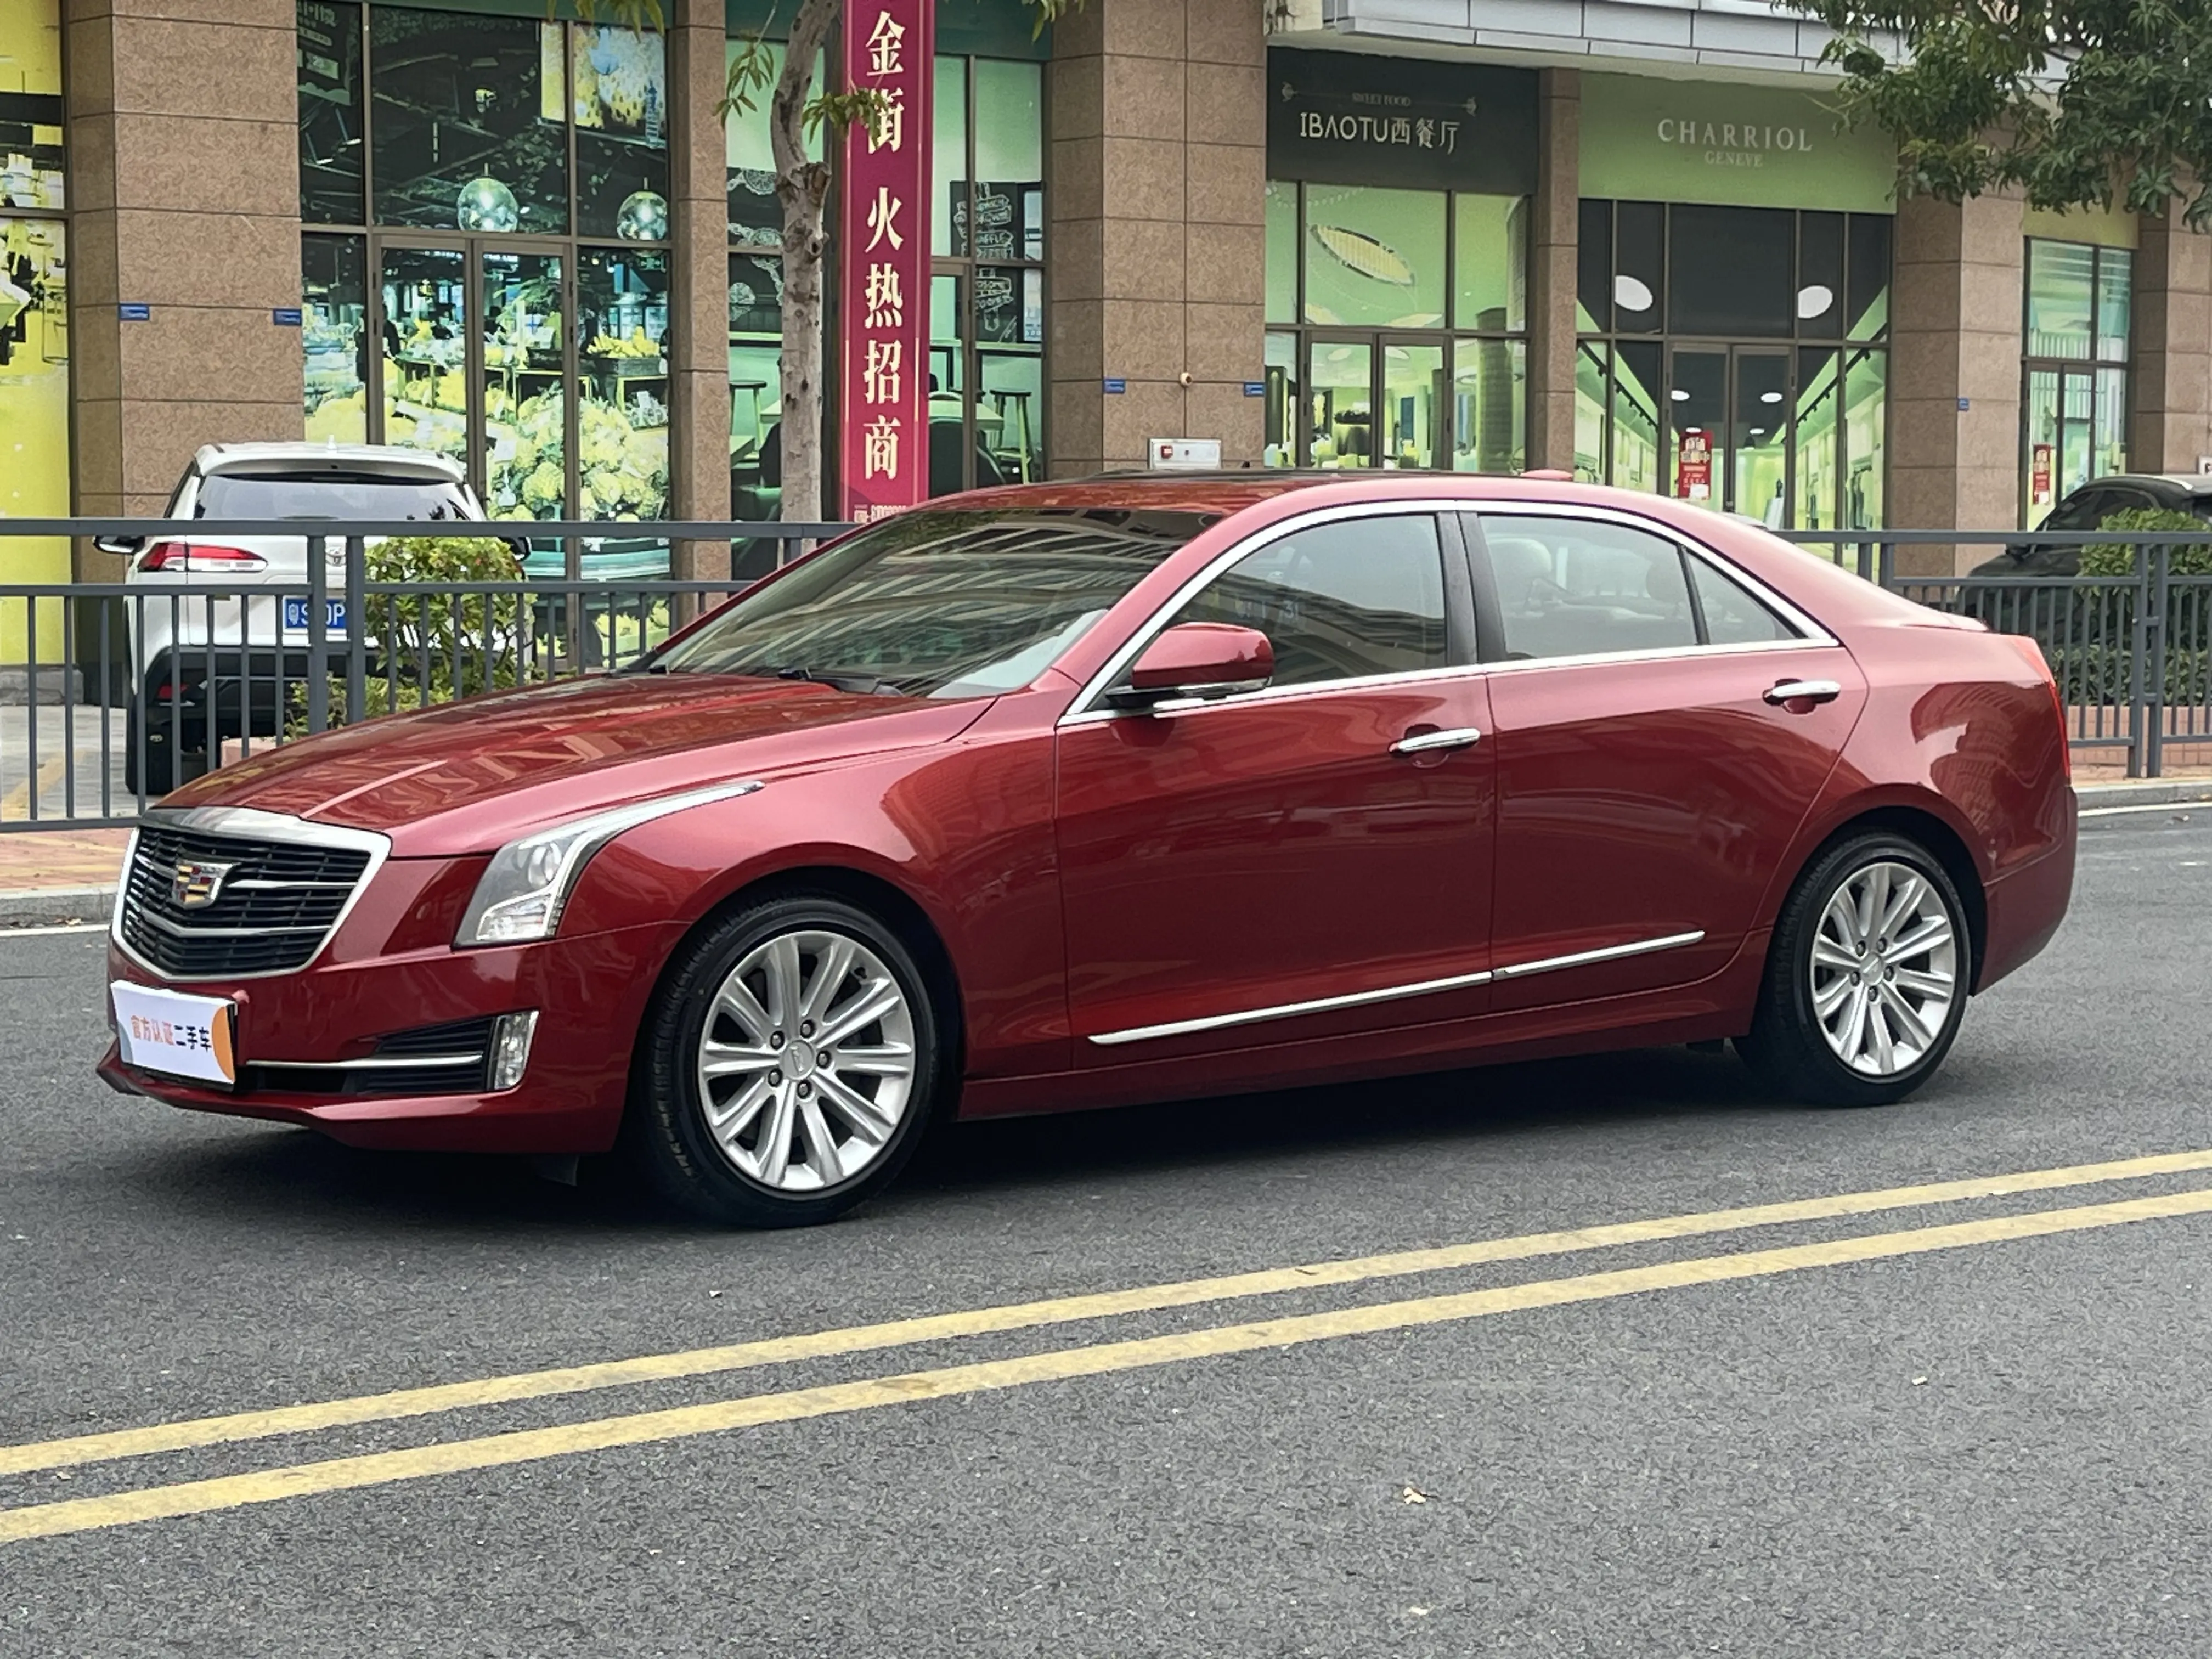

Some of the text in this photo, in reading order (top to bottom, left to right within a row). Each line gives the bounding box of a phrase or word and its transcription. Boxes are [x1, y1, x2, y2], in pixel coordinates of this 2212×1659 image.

[1657, 119, 1813, 151] CHARRIOL
[1704, 150, 1763, 167] GENEVE
[864, 187, 905, 480] 火热招商
